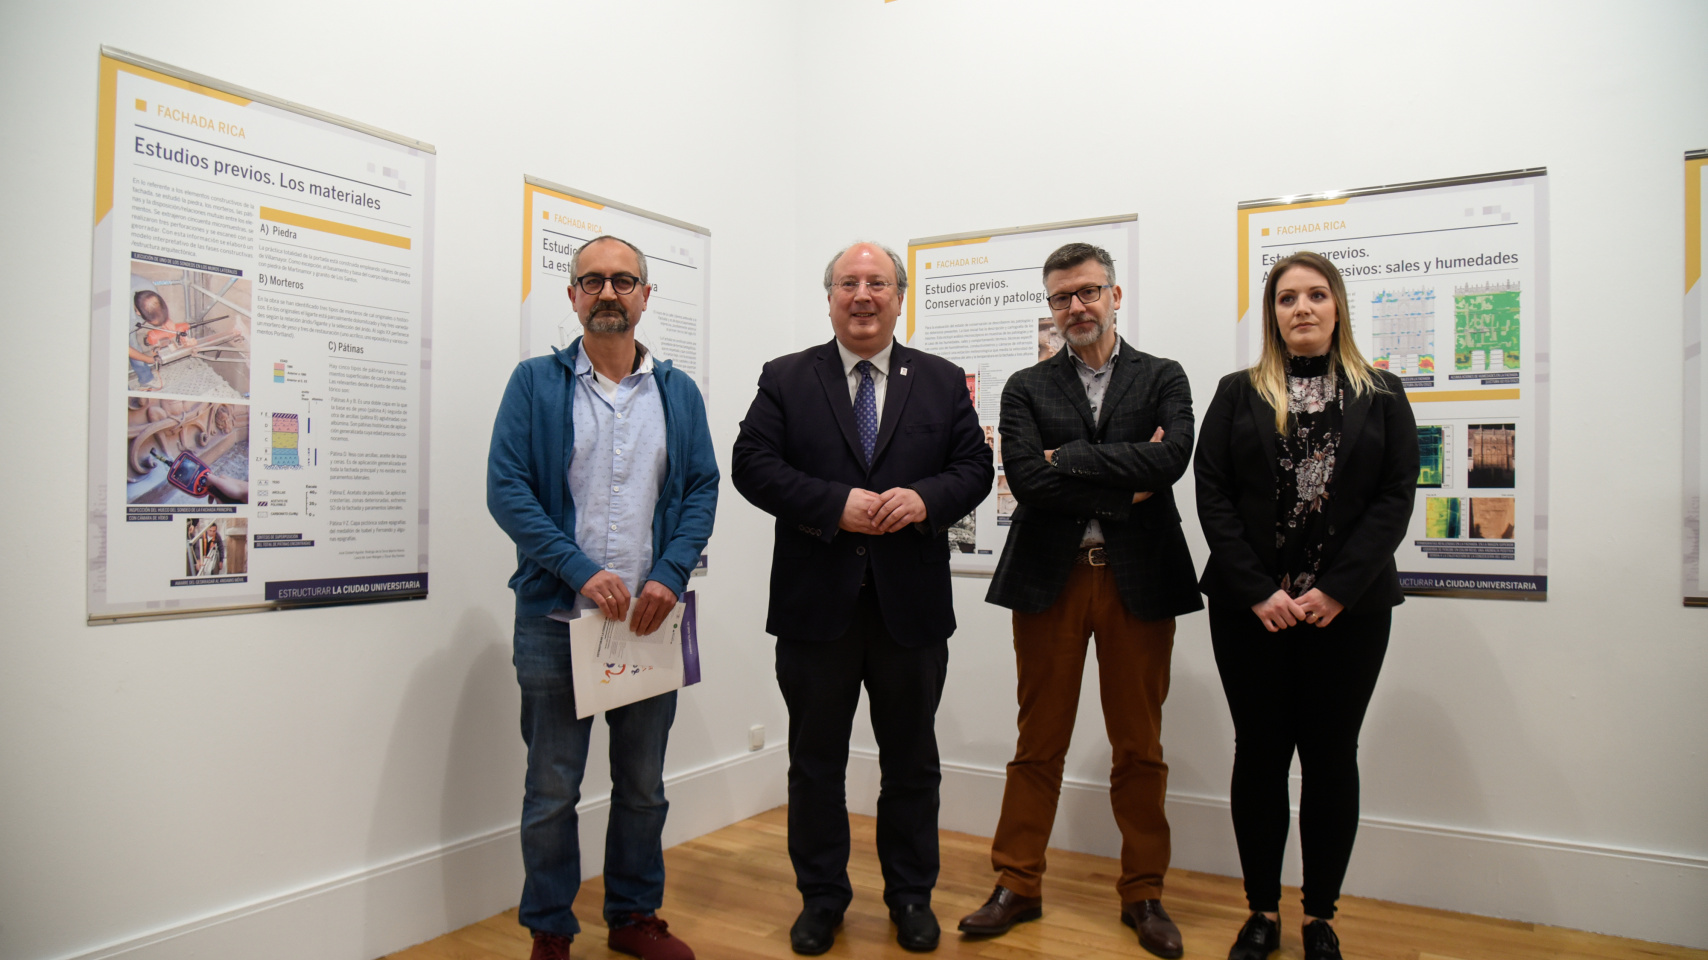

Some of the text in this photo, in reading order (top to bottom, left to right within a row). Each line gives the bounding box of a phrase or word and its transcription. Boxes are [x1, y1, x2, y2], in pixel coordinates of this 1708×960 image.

[158, 104, 246, 139] FACHADA RICA
[135, 136, 381, 210] Estudios previos. Los materiales
[260, 223, 297, 239] A) Piedra
[555, 214, 602, 234] FACHADA RICA
[1277, 220, 1346, 235] FACHADA RICA
[543, 238, 578, 257] Estudi
[543, 256, 554, 270] La
[937, 256, 988, 268] FACHADA RICA
[1338, 250, 1518, 277] esivos: sales y humedades
[259, 274, 304, 290] B) Morteros
[926, 278, 1008, 295] Estudios previos.
[925, 290, 1048, 309] Conservación y patologí
[328, 341, 364, 354] C) Pátinas
[279, 581, 420, 598] ESTRUCTURAR LA CIUDAD UNIVERSITARIA
[1446, 580, 1475, 588] CIUDAD
[1477, 581, 1536, 590] UNIVERSITARIA
